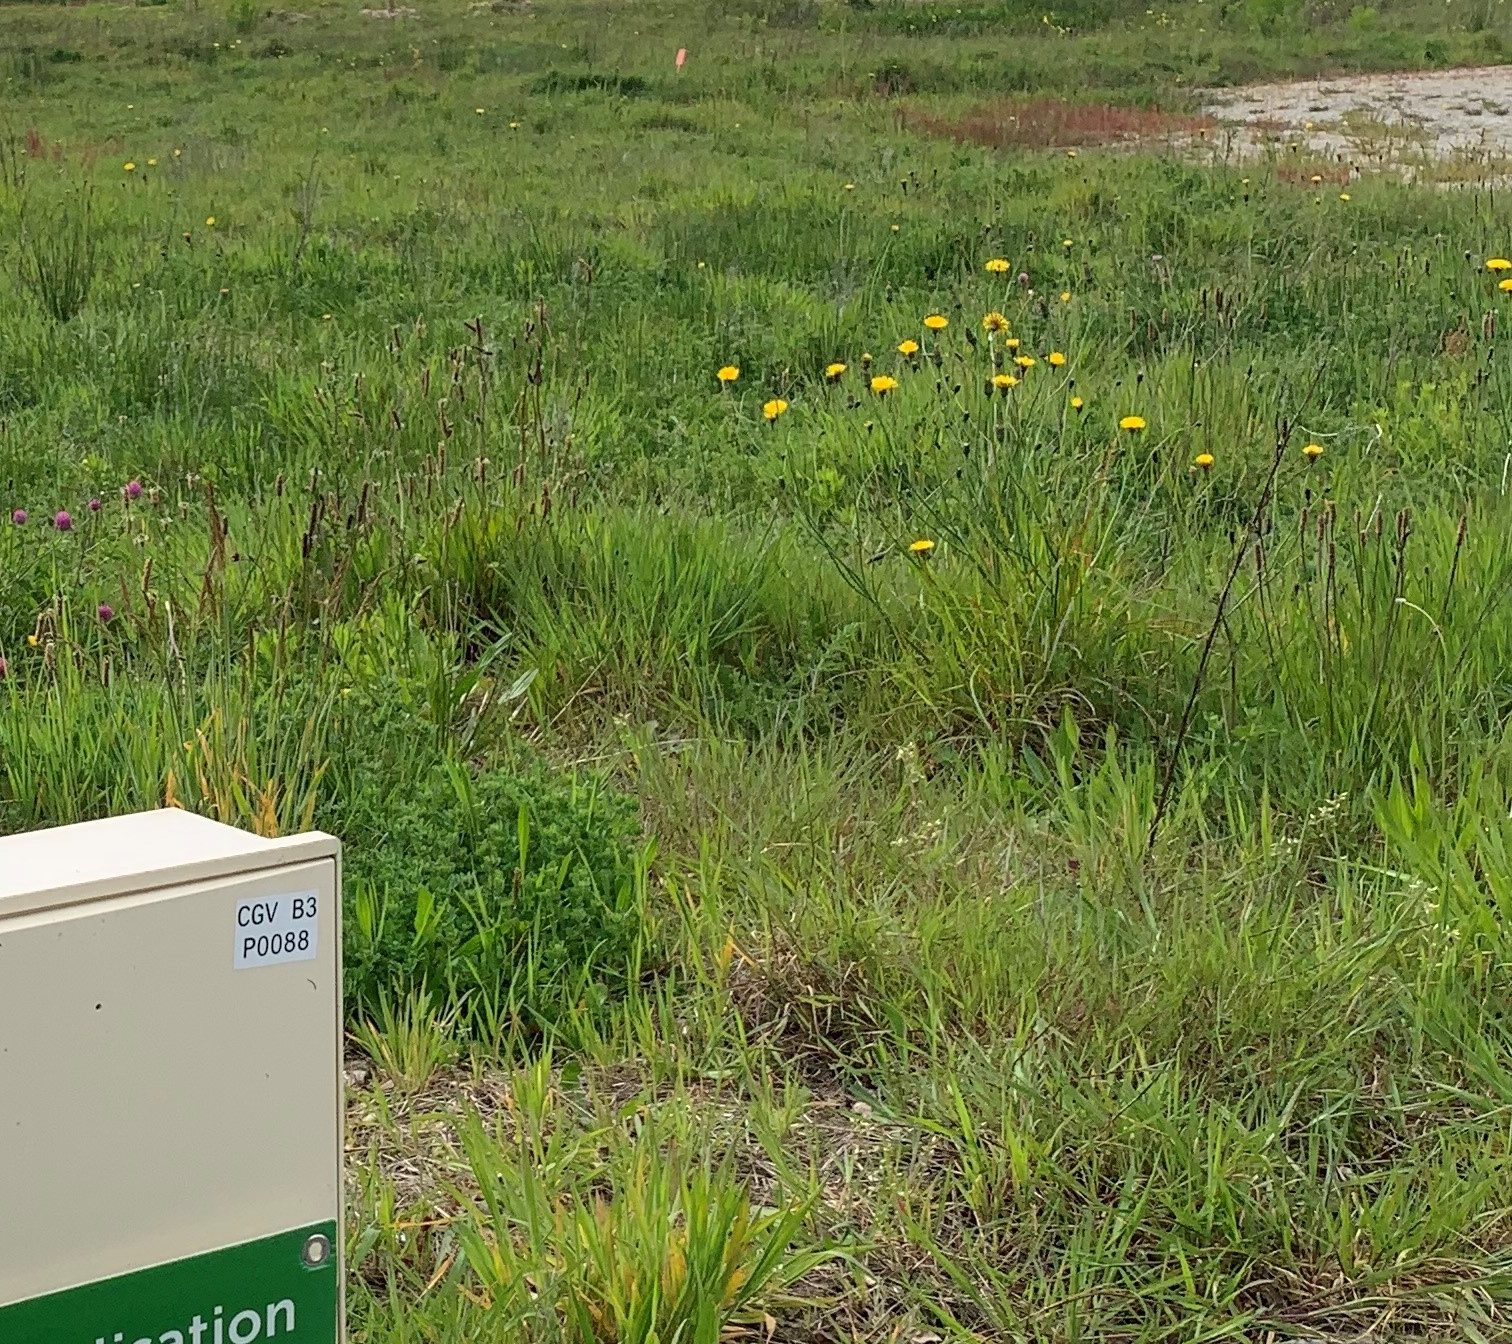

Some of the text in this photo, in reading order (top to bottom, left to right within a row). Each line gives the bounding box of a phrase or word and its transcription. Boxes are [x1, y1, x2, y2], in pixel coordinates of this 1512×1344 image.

[237, 896, 317, 927] CGV B3
[243, 929, 309, 959] P0088
